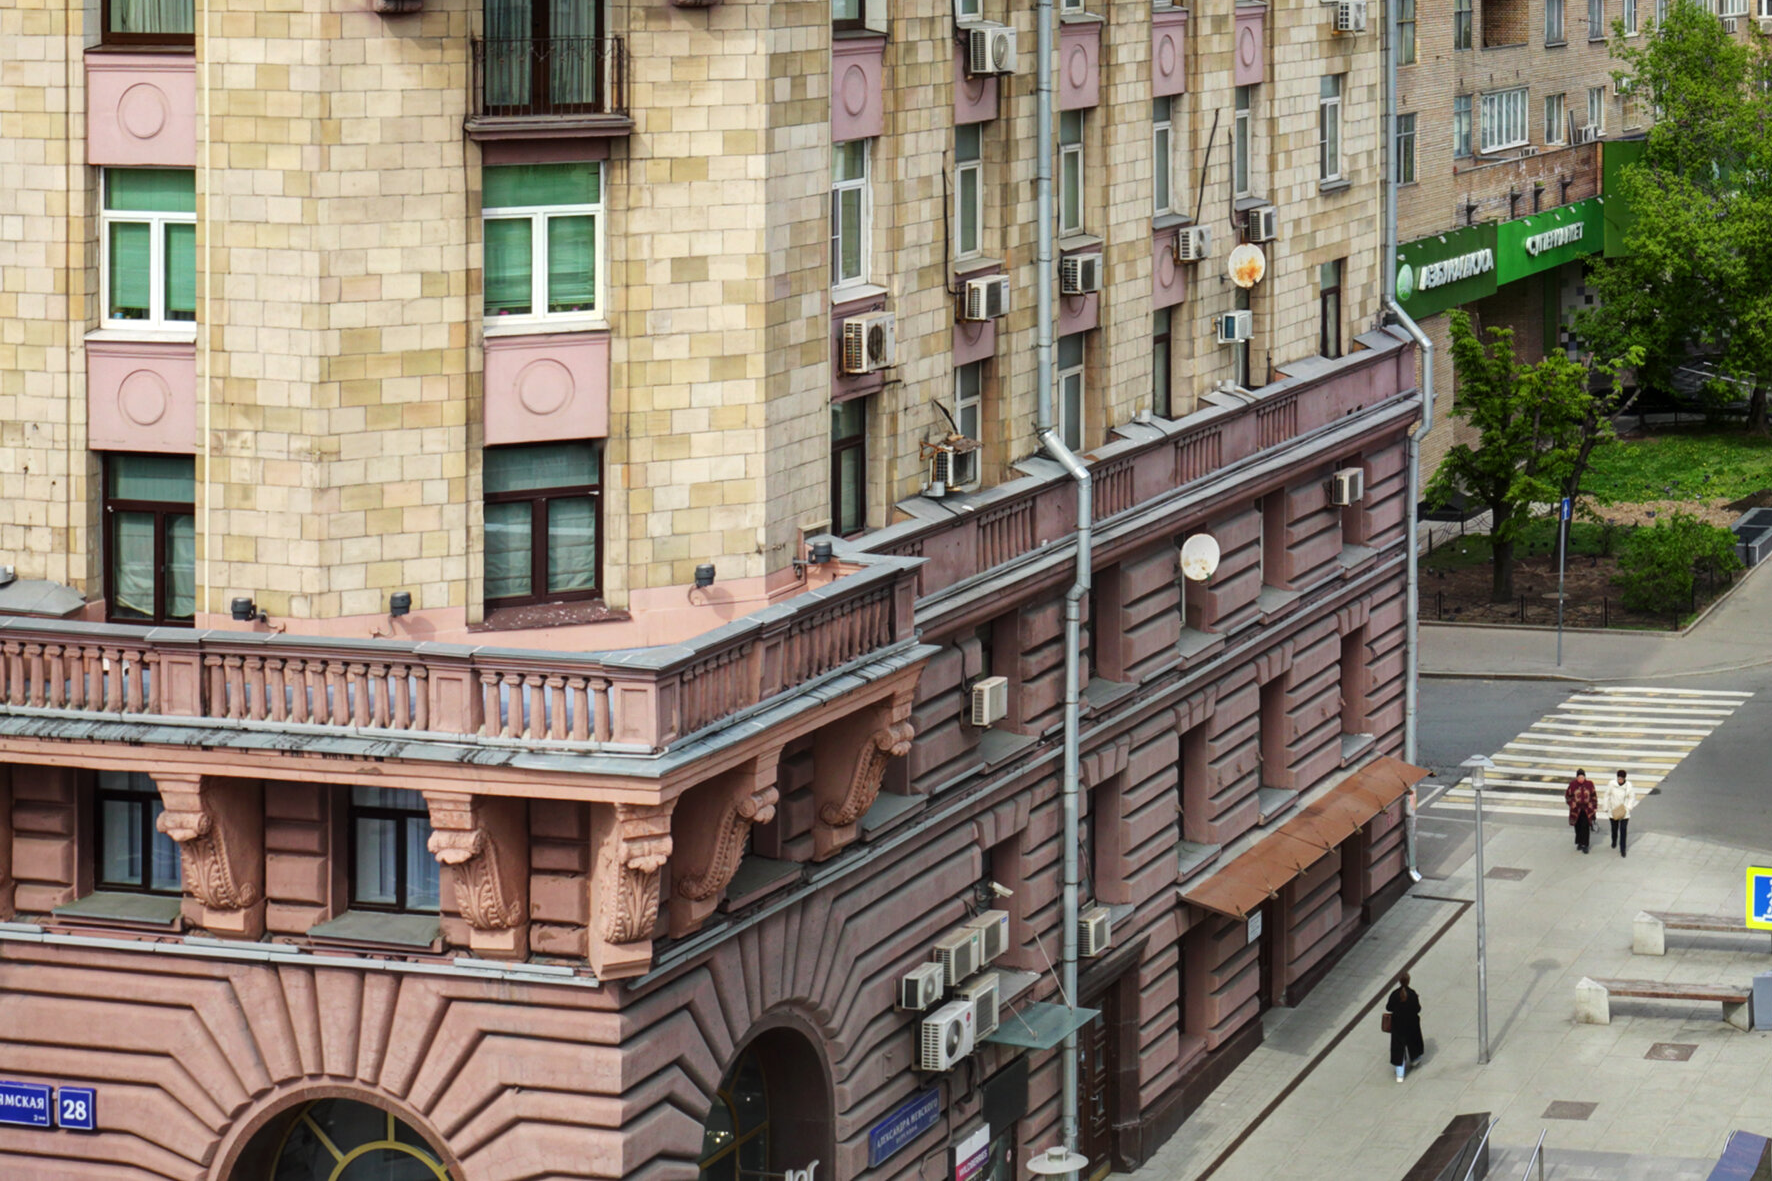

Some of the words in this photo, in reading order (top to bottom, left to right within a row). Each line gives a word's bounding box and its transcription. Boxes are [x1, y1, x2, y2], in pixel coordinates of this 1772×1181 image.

[1526, 221, 1585, 257] СУПЕРМАРКЕТ
[1419, 255, 1464, 291] АЗБУКА
[1463, 248, 1494, 279] ВКУСА
[63, 1099, 87, 1121] 28
[959, 1149, 988, 1176] WILDBERRIES
